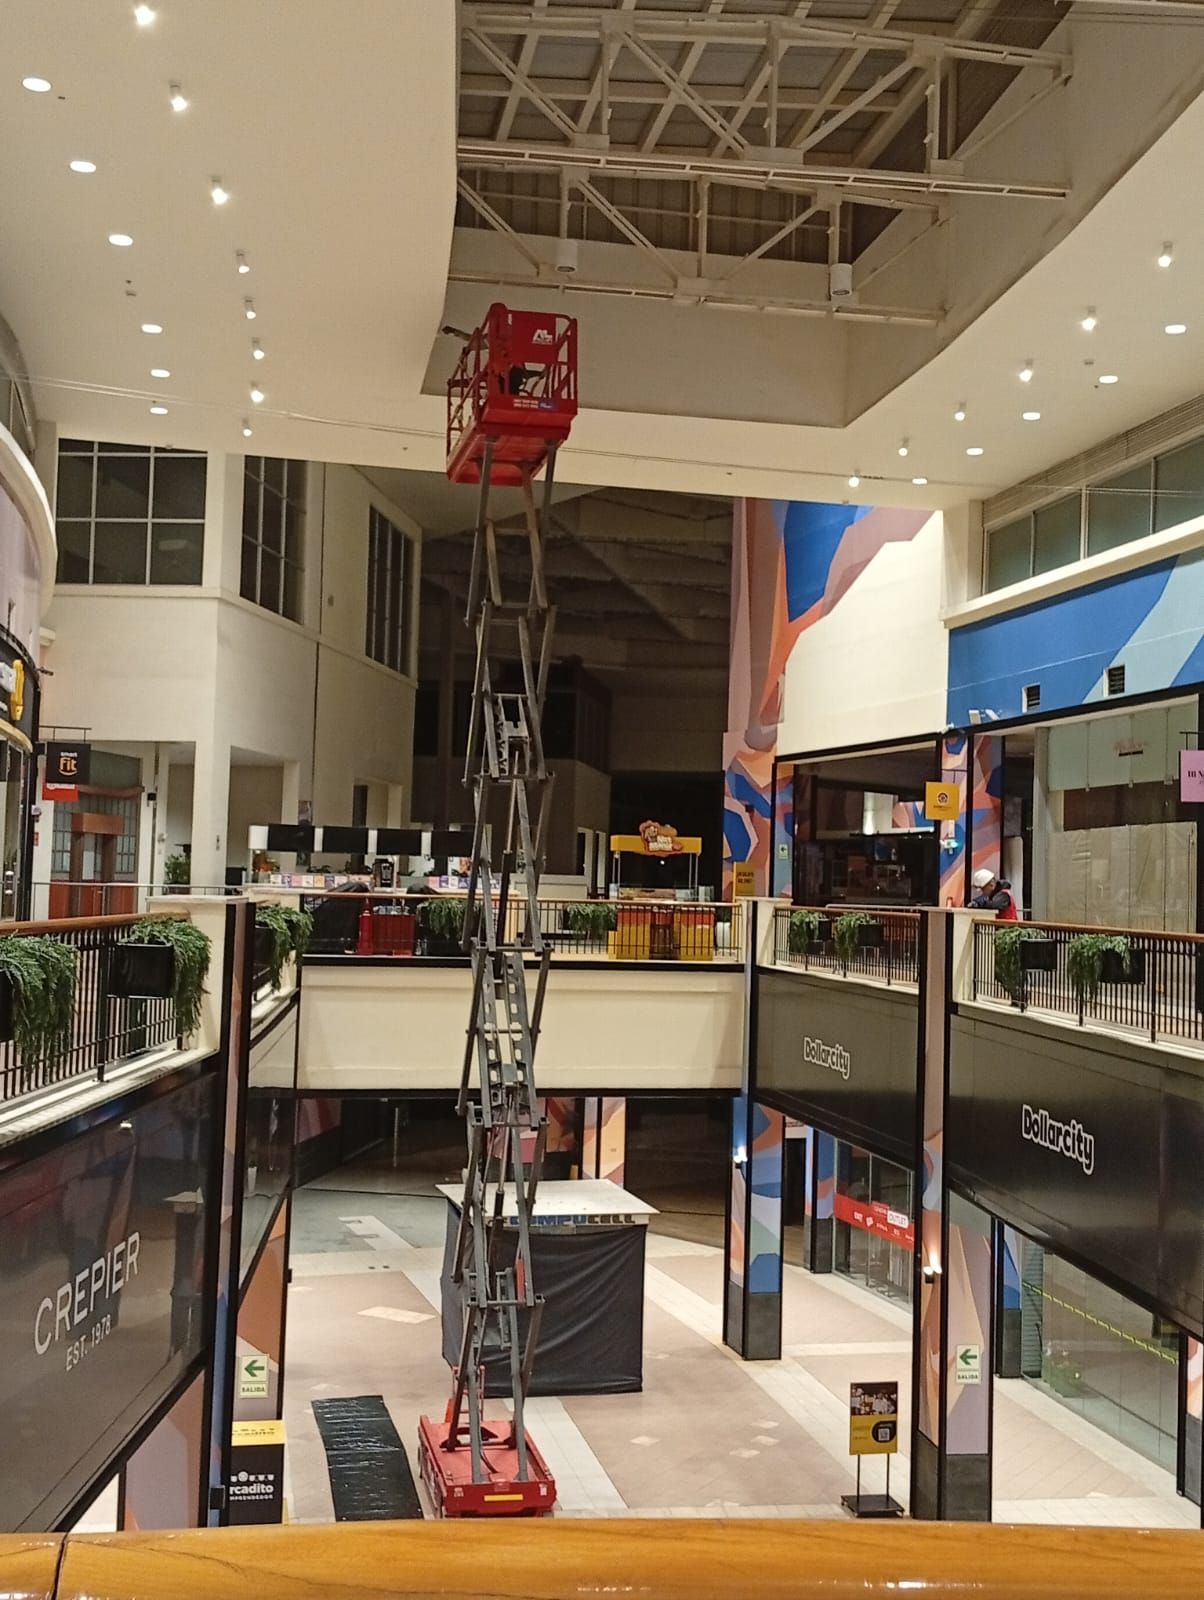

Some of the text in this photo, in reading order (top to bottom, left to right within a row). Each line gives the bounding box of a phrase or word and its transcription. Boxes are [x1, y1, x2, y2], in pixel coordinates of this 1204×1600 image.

[804, 1037, 850, 1081] Dollarcity
[1022, 1103, 1094, 1175] Dollarcity
[34, 1231, 140, 1355] CREPIER
[65, 1314, 111, 1371] EST. 1978
[229, 1482, 274, 1495] rcadito
